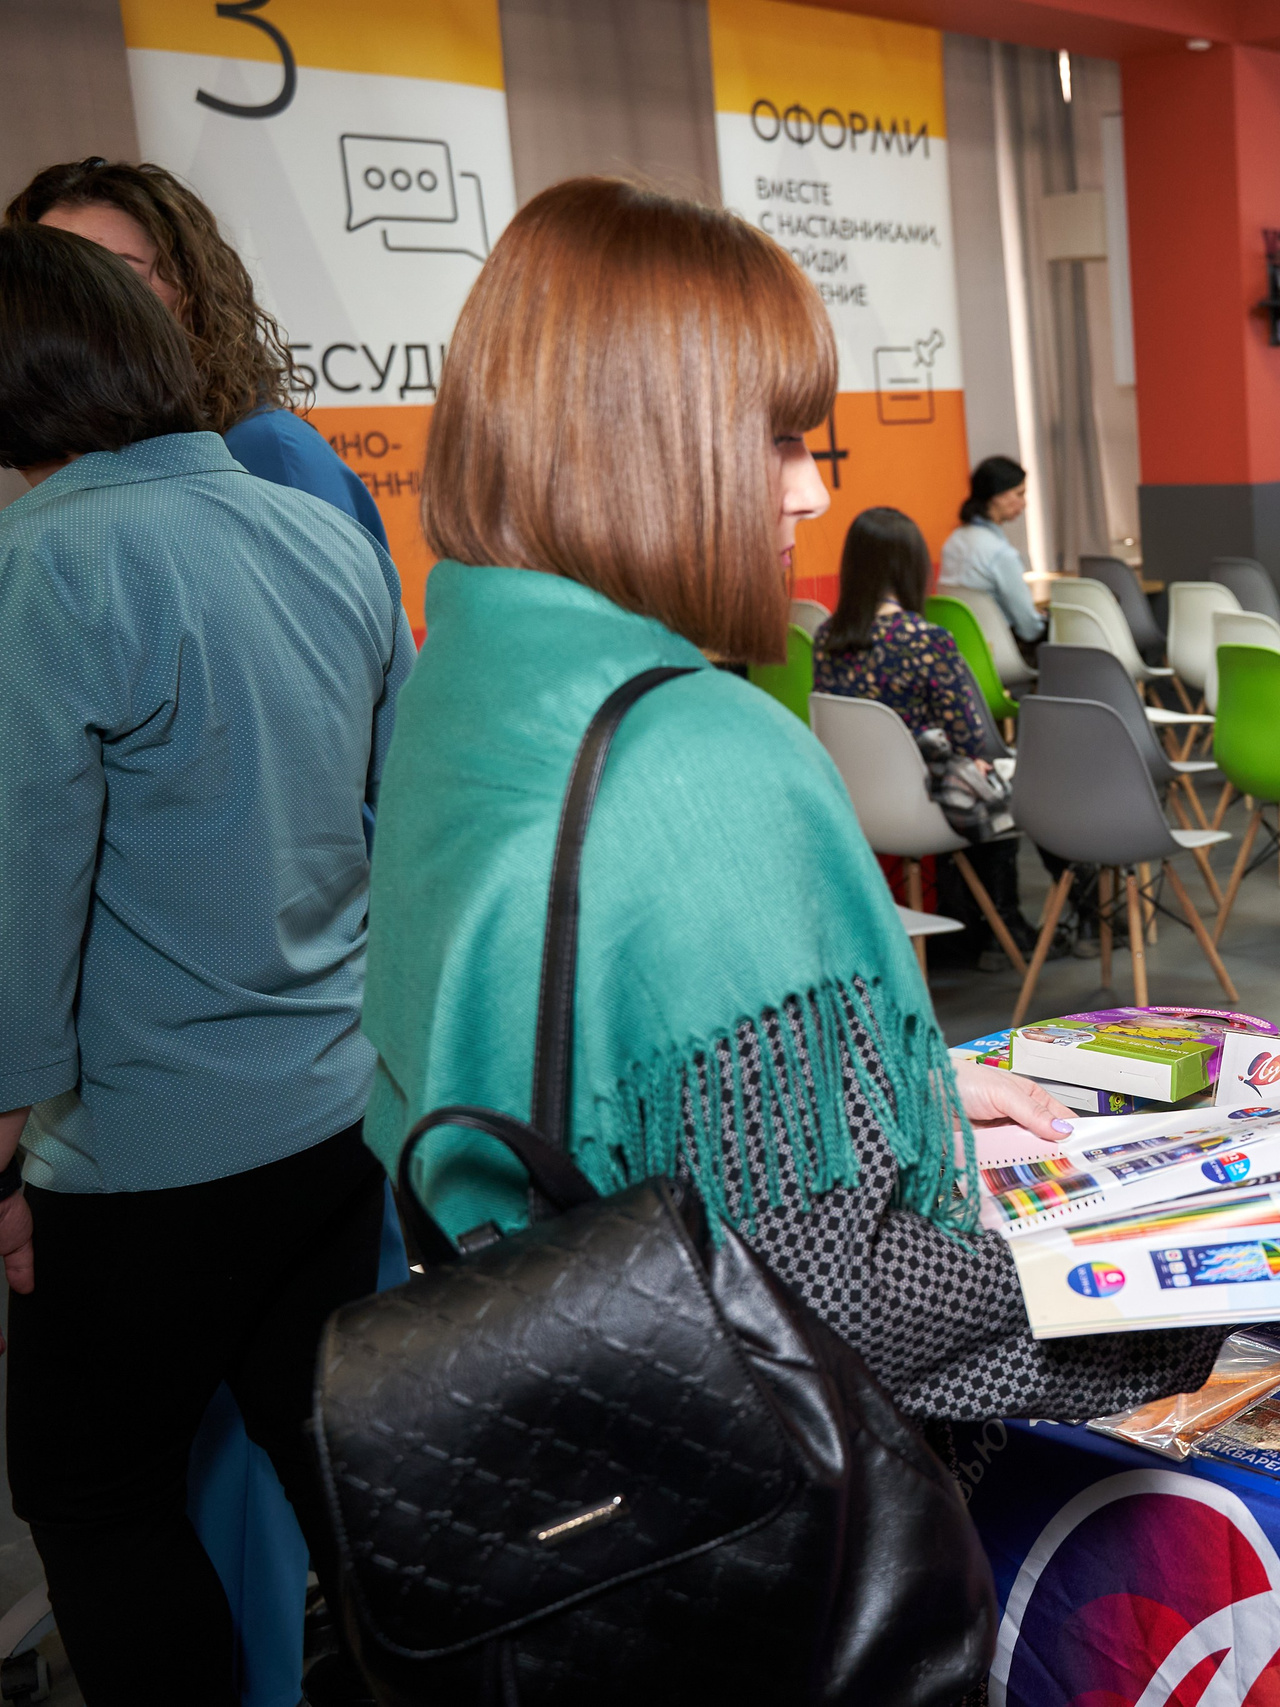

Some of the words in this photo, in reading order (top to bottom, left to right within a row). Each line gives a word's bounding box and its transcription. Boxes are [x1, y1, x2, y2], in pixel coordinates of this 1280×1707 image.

[194, 0, 299, 119] 3
[751, 98, 931, 160] ОФОРМИ
[755, 175, 833, 206] ВМЕСТЕ
[759, 210, 774, 234] С
[778, 213, 942, 248] НАСТАВНИКАМИ,
[789, 244, 849, 274] ОЙДИ
[286, 342, 446, 400] БСУД
